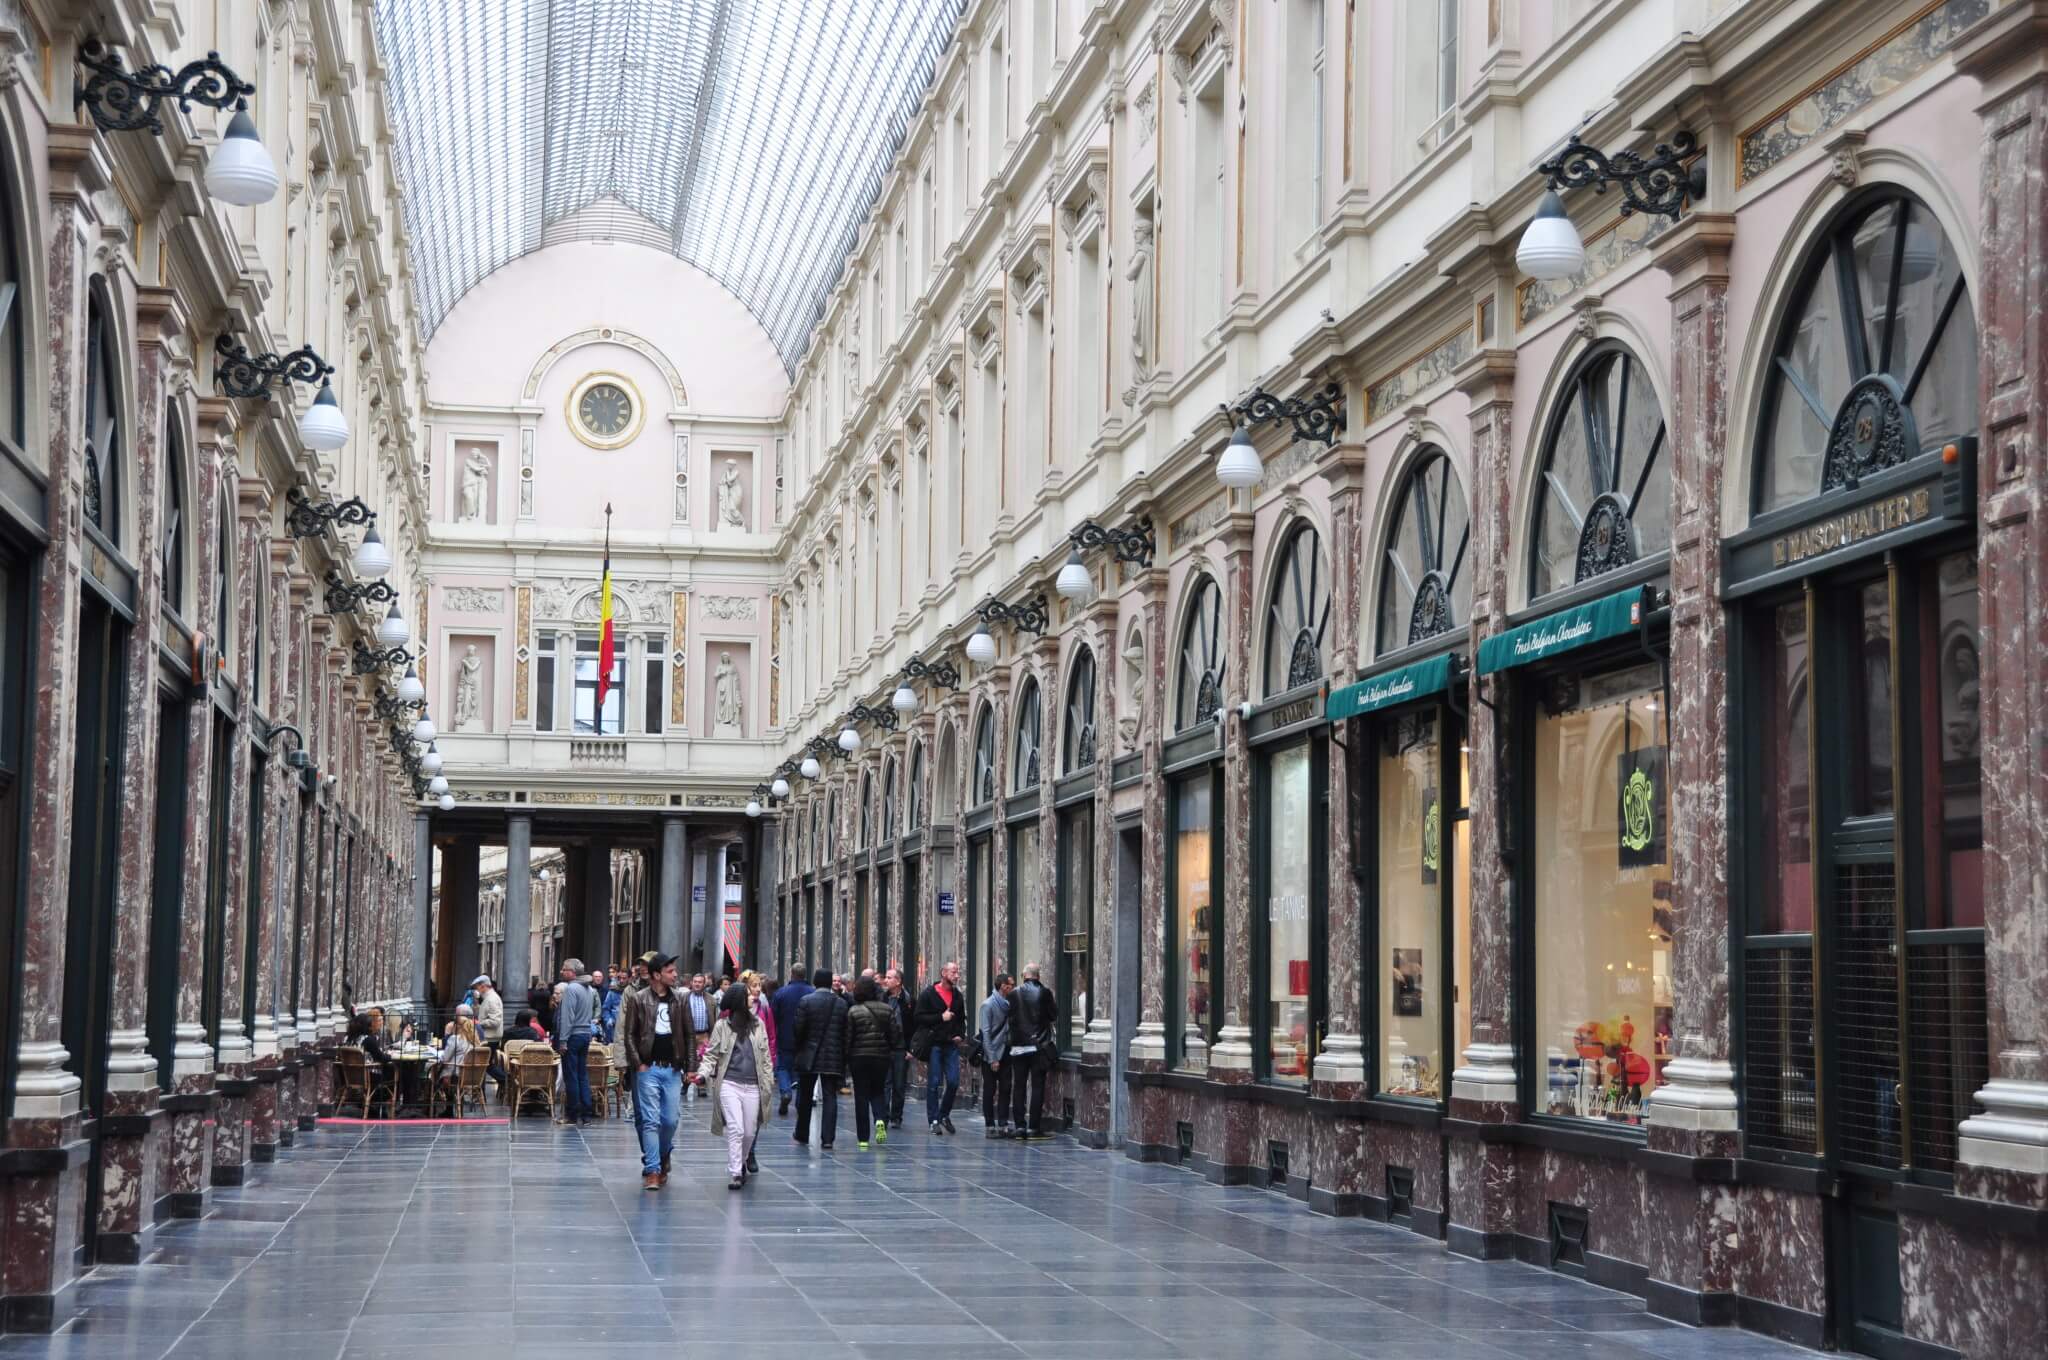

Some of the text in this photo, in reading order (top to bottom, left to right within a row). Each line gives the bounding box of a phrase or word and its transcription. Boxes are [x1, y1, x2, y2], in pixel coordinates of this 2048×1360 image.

[1788, 495, 1911, 562] MAISON HALTER
[1531, 627, 1557, 655] Belgian
[1557, 616, 1593, 643] Chocolates
[1268, 897, 1279, 921] LE
